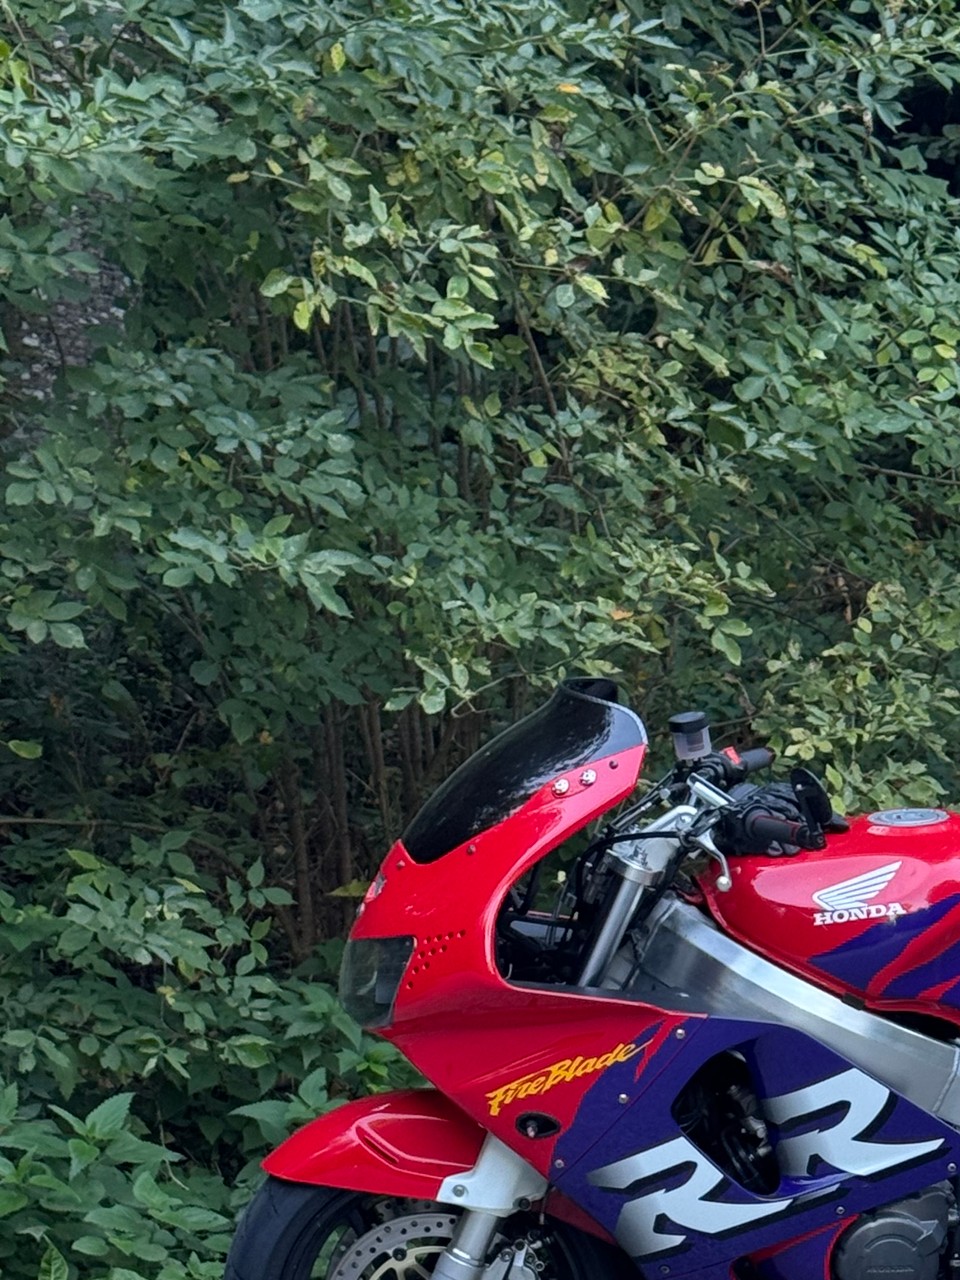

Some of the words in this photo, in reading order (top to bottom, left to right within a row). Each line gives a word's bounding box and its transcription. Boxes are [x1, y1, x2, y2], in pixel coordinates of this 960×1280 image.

[813, 902, 907, 926] HONDA
[485, 1039, 653, 1116] FireBlade
[586, 1067, 945, 1258] RR
